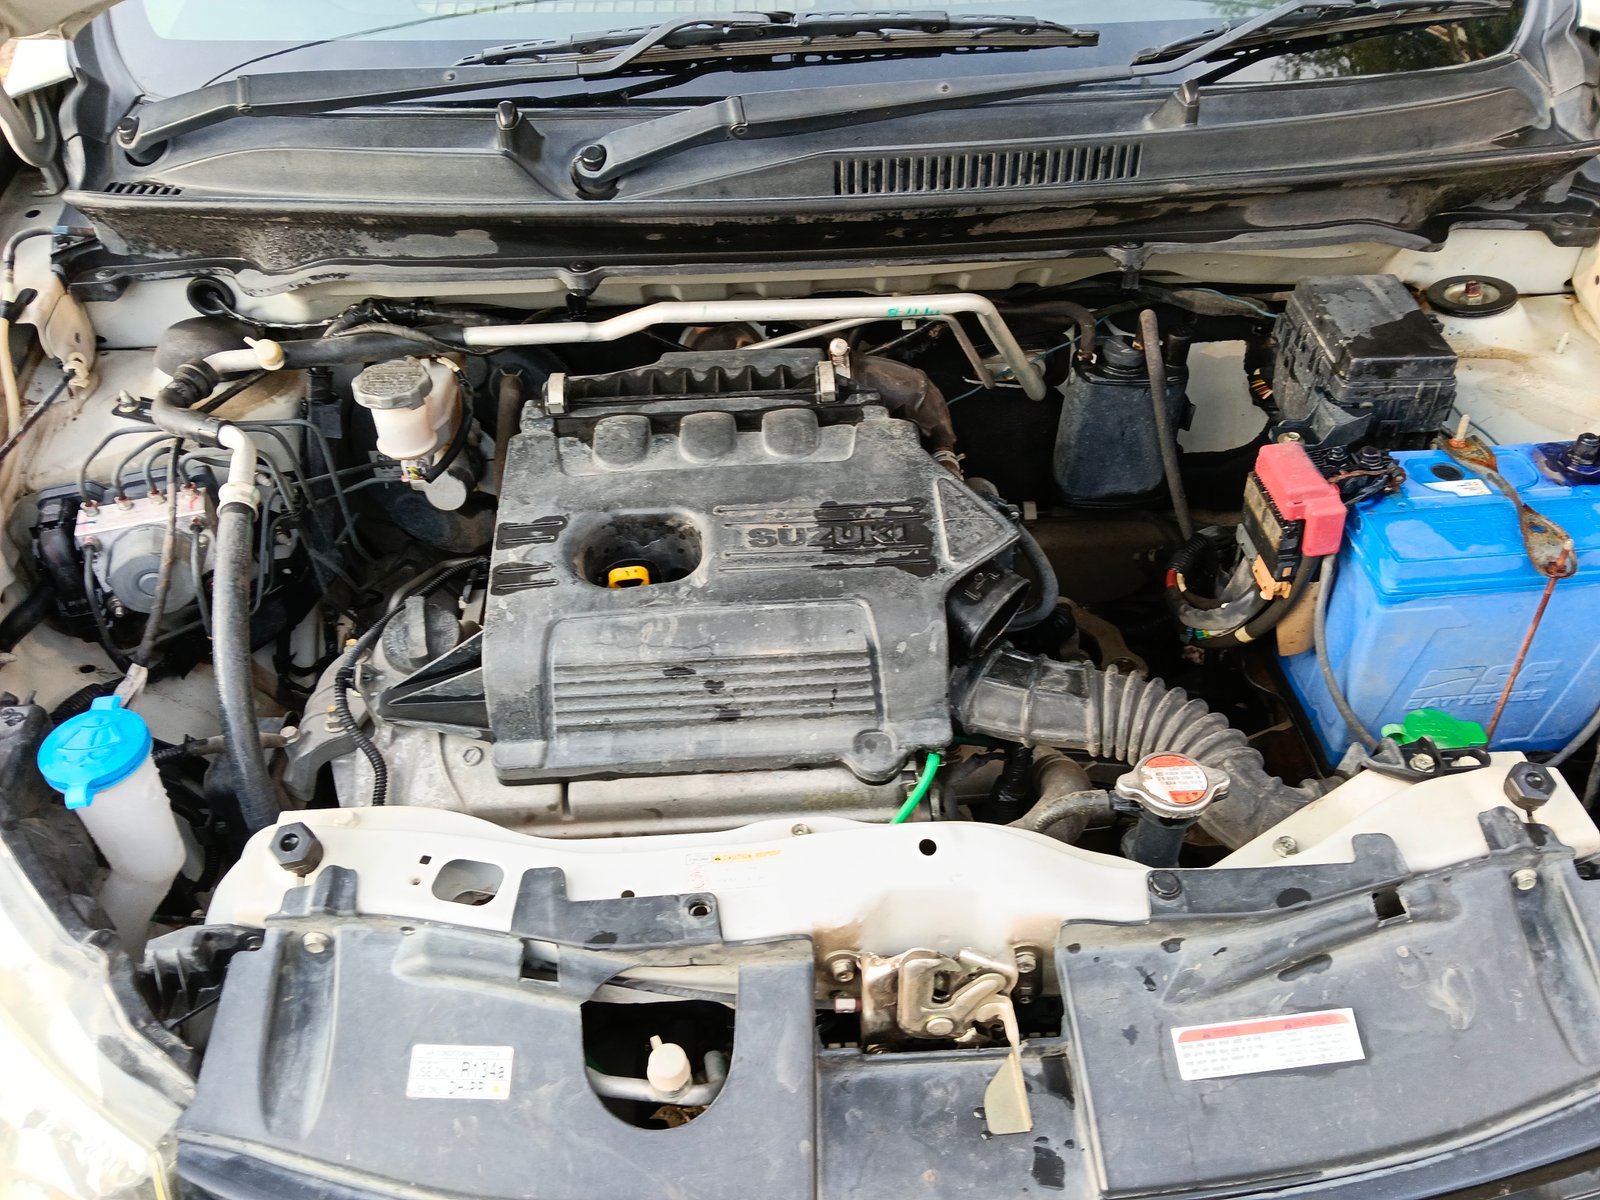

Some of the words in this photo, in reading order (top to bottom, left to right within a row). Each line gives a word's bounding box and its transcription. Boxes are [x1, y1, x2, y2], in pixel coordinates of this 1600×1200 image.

[748, 523, 907, 547] SUZUKI
[1470, 661, 1562, 694] SF
[1403, 689, 1548, 711] BATTERES
[461, 1061, 506, 1079] R134a
